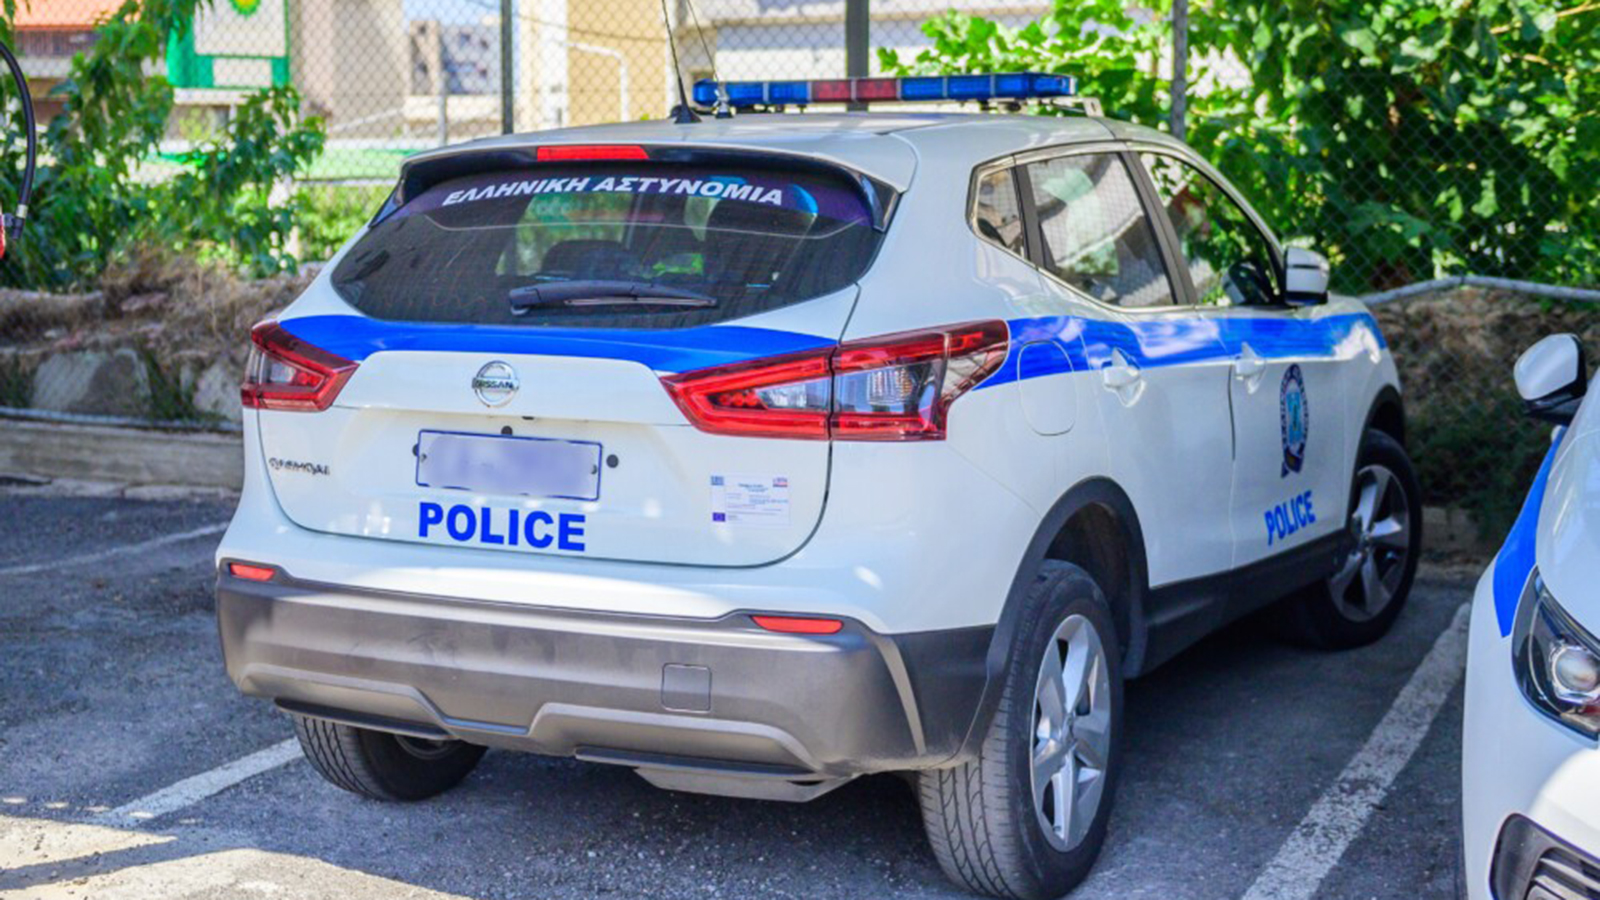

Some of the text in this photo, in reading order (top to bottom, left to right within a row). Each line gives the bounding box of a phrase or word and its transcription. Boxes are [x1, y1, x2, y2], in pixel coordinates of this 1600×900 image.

[442, 177, 783, 206] ΕΛΛΗΝΙΚΗ ΑΣΤΥΝΟΜΙΑ
[418, 501, 586, 552] POLICE
[1264, 490, 1316, 546] POLICE
